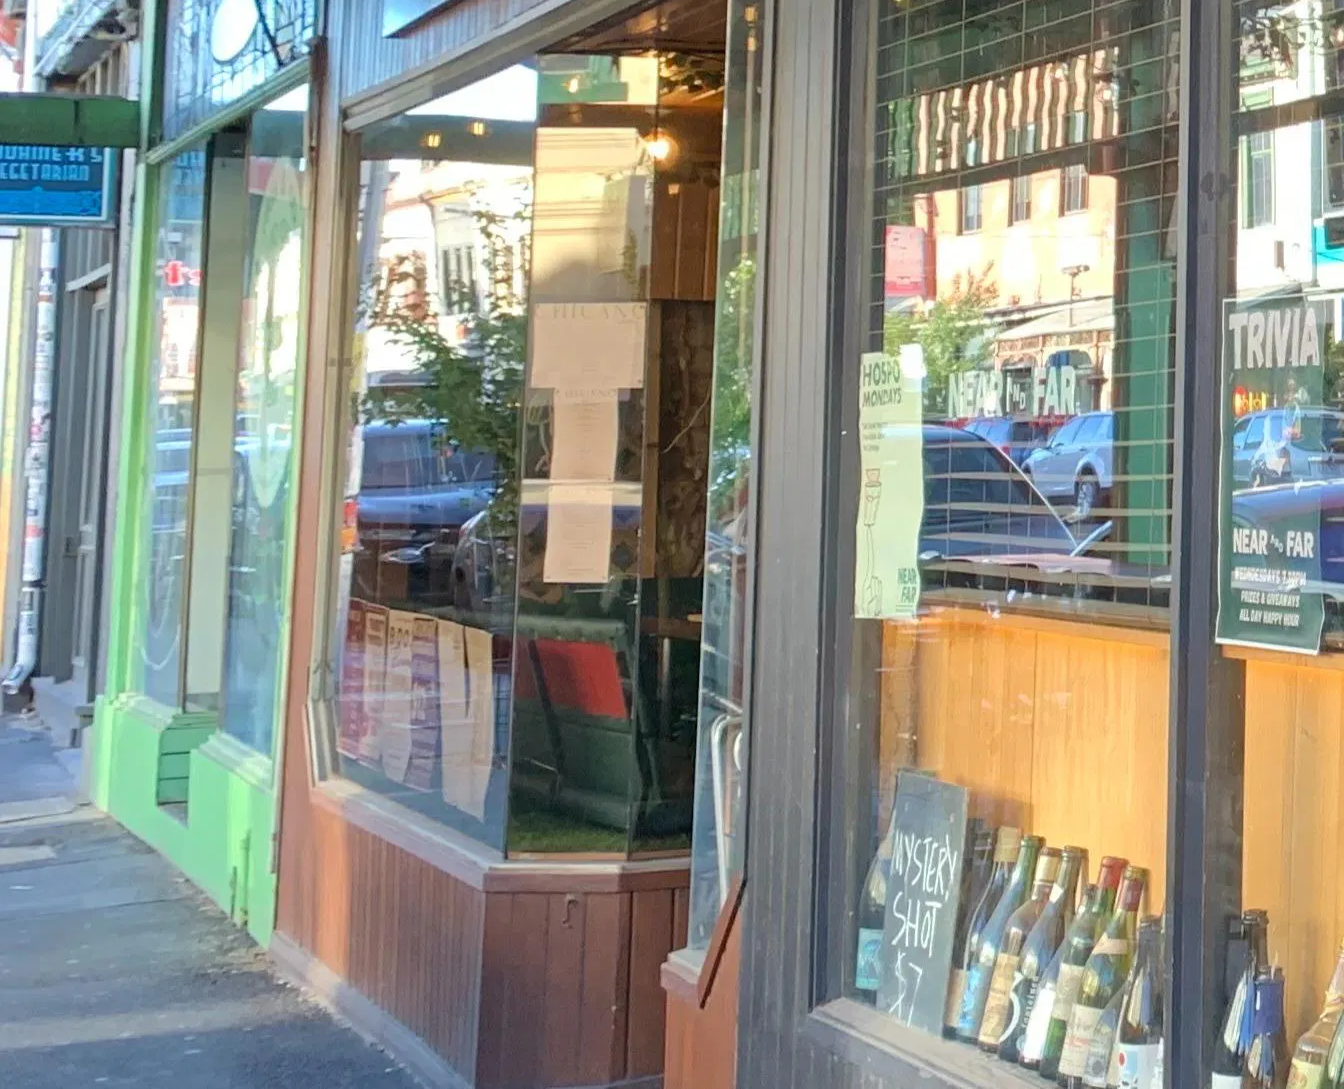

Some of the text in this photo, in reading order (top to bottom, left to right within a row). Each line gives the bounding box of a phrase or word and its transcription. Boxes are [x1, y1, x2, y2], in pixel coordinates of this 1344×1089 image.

[1227, 307, 1320, 370] TRIVIA
[862, 359, 901, 388] HOSPO
[948, 369, 1004, 419] NEAR
[1033, 364, 1076, 416] FAR
[1233, 527, 1268, 555] NEAR
[1286, 530, 1314, 559] FAR
[898, 567, 918, 586] NEAR
[900, 585, 917, 605] FAR
[892, 830, 958, 902] MYSTERY
[891, 891, 943, 958] SHOT
